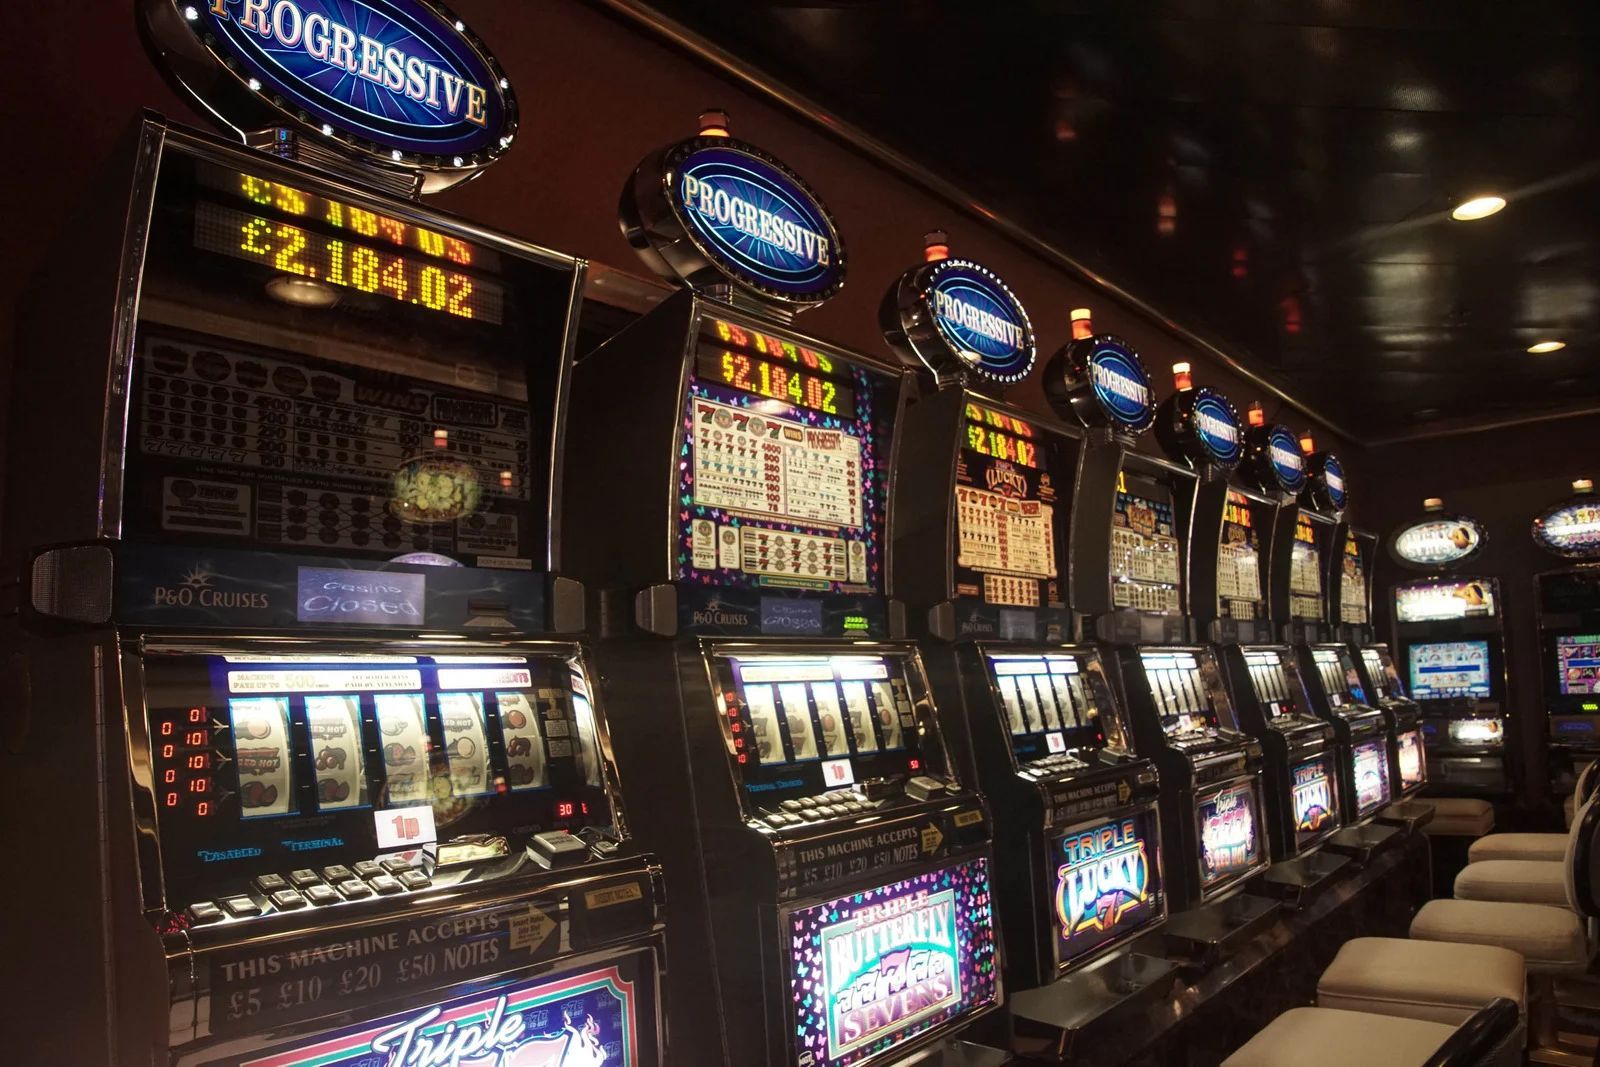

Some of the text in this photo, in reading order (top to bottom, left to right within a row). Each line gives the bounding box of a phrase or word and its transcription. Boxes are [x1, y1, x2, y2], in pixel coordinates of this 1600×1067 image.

[684, 173, 829, 266] PROGRESSIVE
[935, 289, 1024, 350] PROGRESSIVE
[766, 492, 781, 503] 100
[155, 586, 268, 609] P&O CRUISES
[303, 595, 421, 616] Closed
[715, 611, 748, 625] CRUISES
[190, 709, 199, 722] 0
[162, 722, 171, 736] 0
[186, 732, 201, 745] 10
[163, 745, 173, 758] 0
[188, 756, 203, 769] 10
[165, 769, 175, 783] 0
[190, 779, 206, 792] 10
[167, 792, 177, 806] 0
[198, 802, 207, 816] 0
[559, 804, 572, 816] 30
[392, 815, 419, 840] 1p
[281, 838, 344, 851] TERMINAL
[800, 827, 918, 864] THIS MACHINE ACCEPTS
[1063, 820, 1135, 865] TRIPLE
[893, 843, 918, 865] NOTES
[1063, 850, 1141, 935] LUCKY
[852, 889, 929, 929] TRIPLE
[220, 955, 281, 983] THIS
[289, 932, 400, 969] MACHINE
[407, 912, 500, 946] ACCEPTS
[828, 901, 953, 994] BUTTERFLY
[226, 988, 262, 1019] £5
[276, 976, 322, 1010] £10
[339, 963, 381, 996] £20
[395, 952, 436, 983] £50
[443, 937, 500, 970] NOTES
[844, 976, 948, 1043] SEVENS
[372, 994, 526, 1067] Triple
